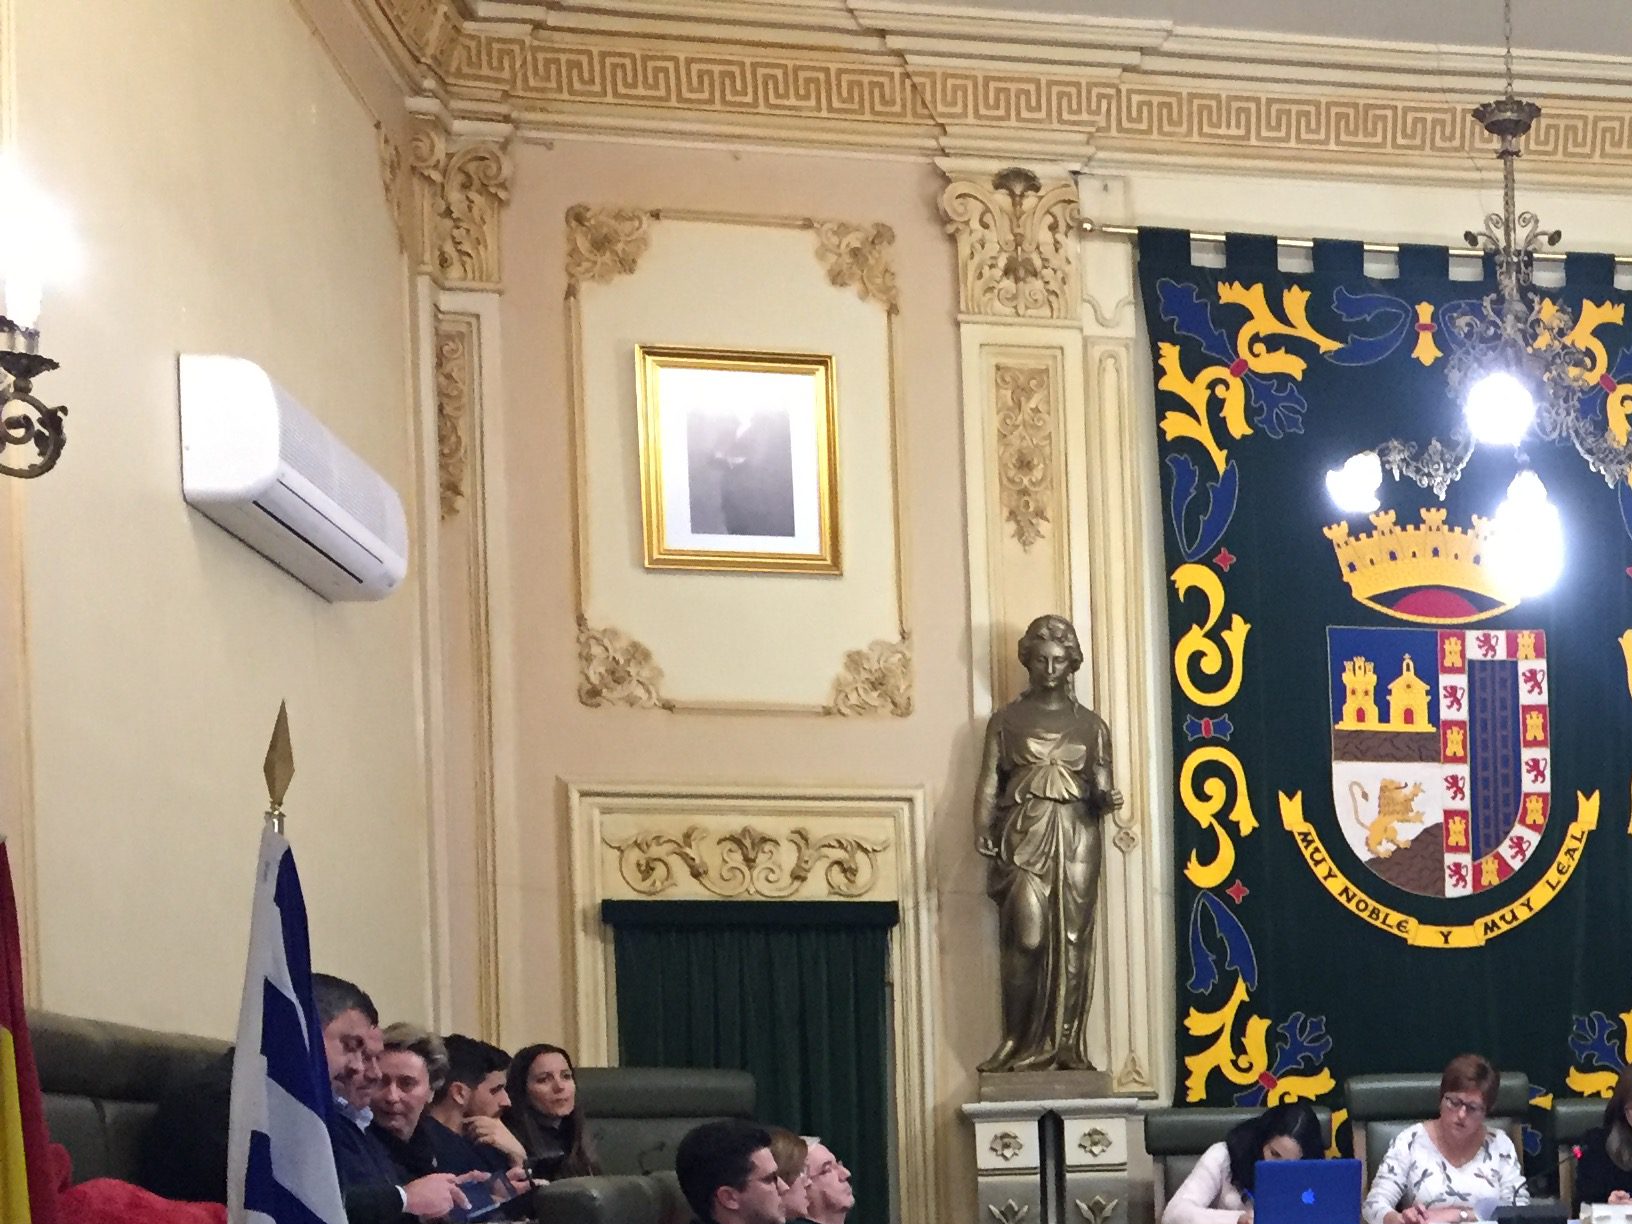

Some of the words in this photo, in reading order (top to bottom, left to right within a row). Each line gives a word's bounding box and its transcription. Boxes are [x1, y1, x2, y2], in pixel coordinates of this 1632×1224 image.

[1297, 830, 1339, 881] MUY
[1338, 884, 1410, 934] NOBLE
[1439, 930, 1453, 945] Y
[1482, 898, 1536, 936] MUY
[1547, 828, 1586, 892] LEAL
